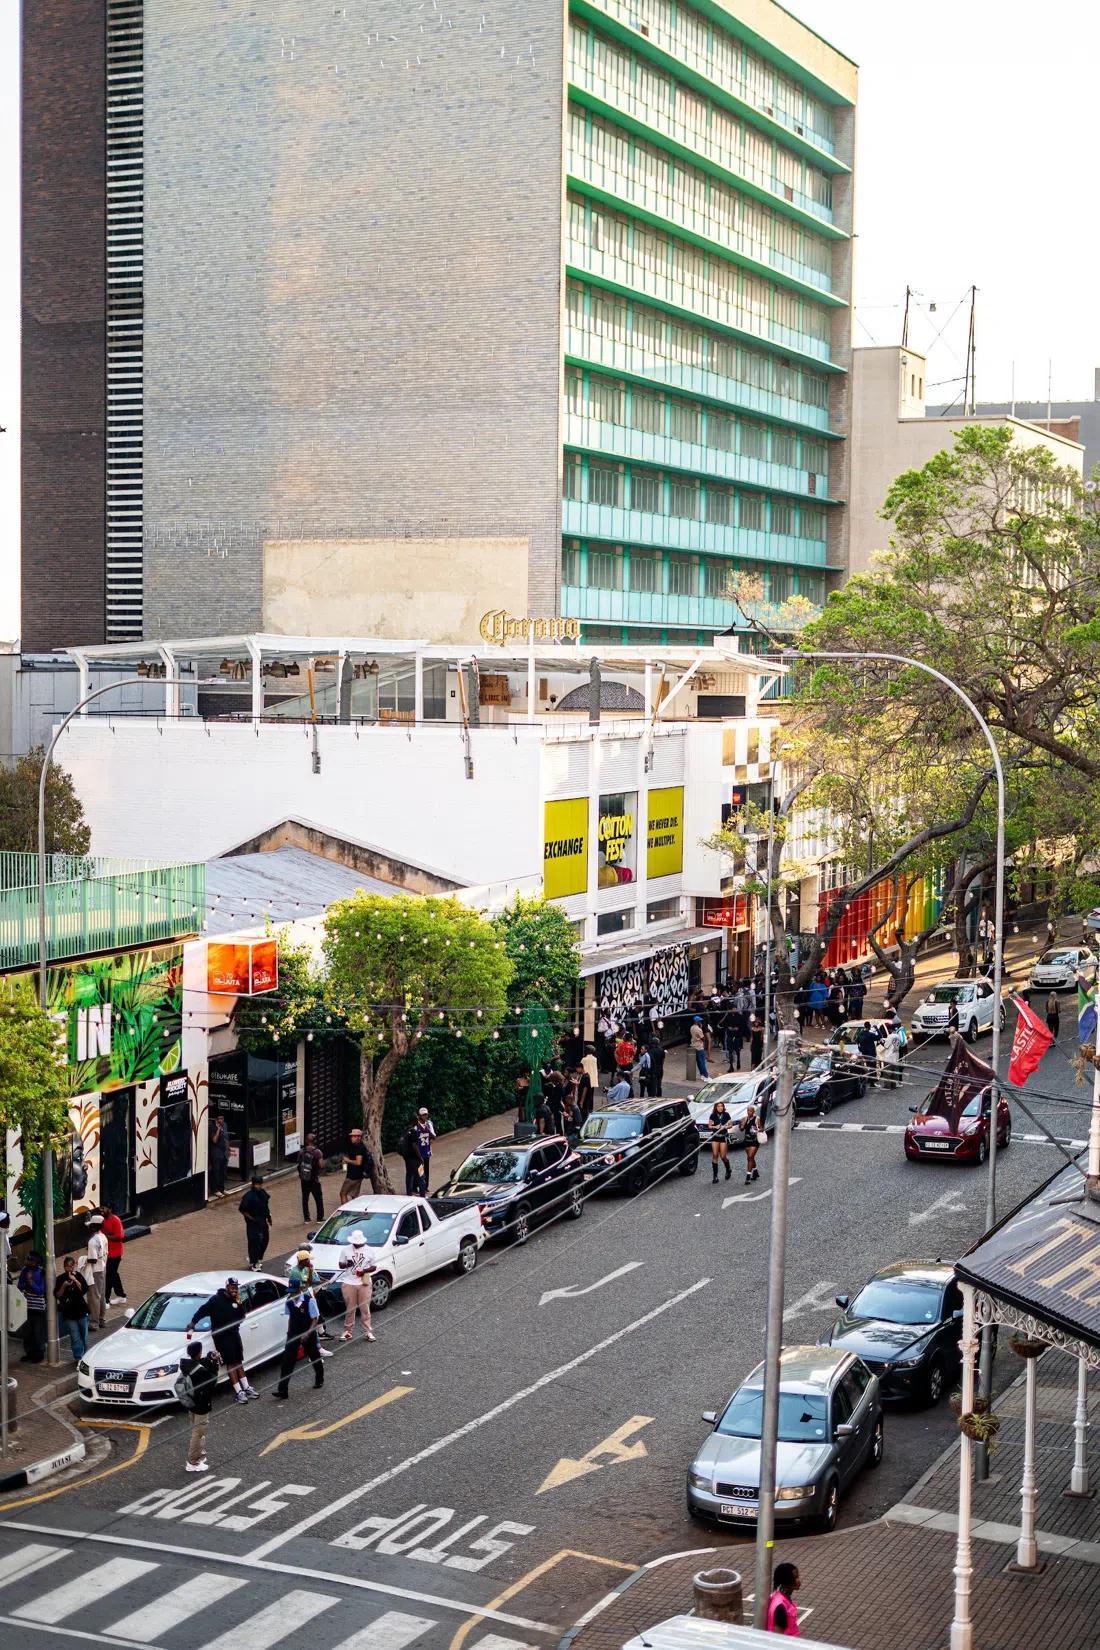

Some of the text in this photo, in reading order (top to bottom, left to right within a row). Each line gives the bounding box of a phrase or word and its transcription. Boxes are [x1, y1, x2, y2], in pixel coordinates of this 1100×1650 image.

[479, 609, 582, 647] Corona
[599, 814, 633, 841] COTTON
[648, 819, 655, 831] WE
[656, 817, 669, 830] NEVER
[544, 837, 584, 860] EXCHANGE
[605, 838, 626, 865] FEST
[654, 833, 676, 848] MULTIPLY.
[1010, 1027, 1034, 1062] CASTL
[420, 1137, 430, 1146] 24
[51, 1457, 65, 1469] JUTA
[115, 1474, 318, 1532] STOP
[737, 1507, 749, 1515] 512
[328, 1503, 538, 1573] STOP
